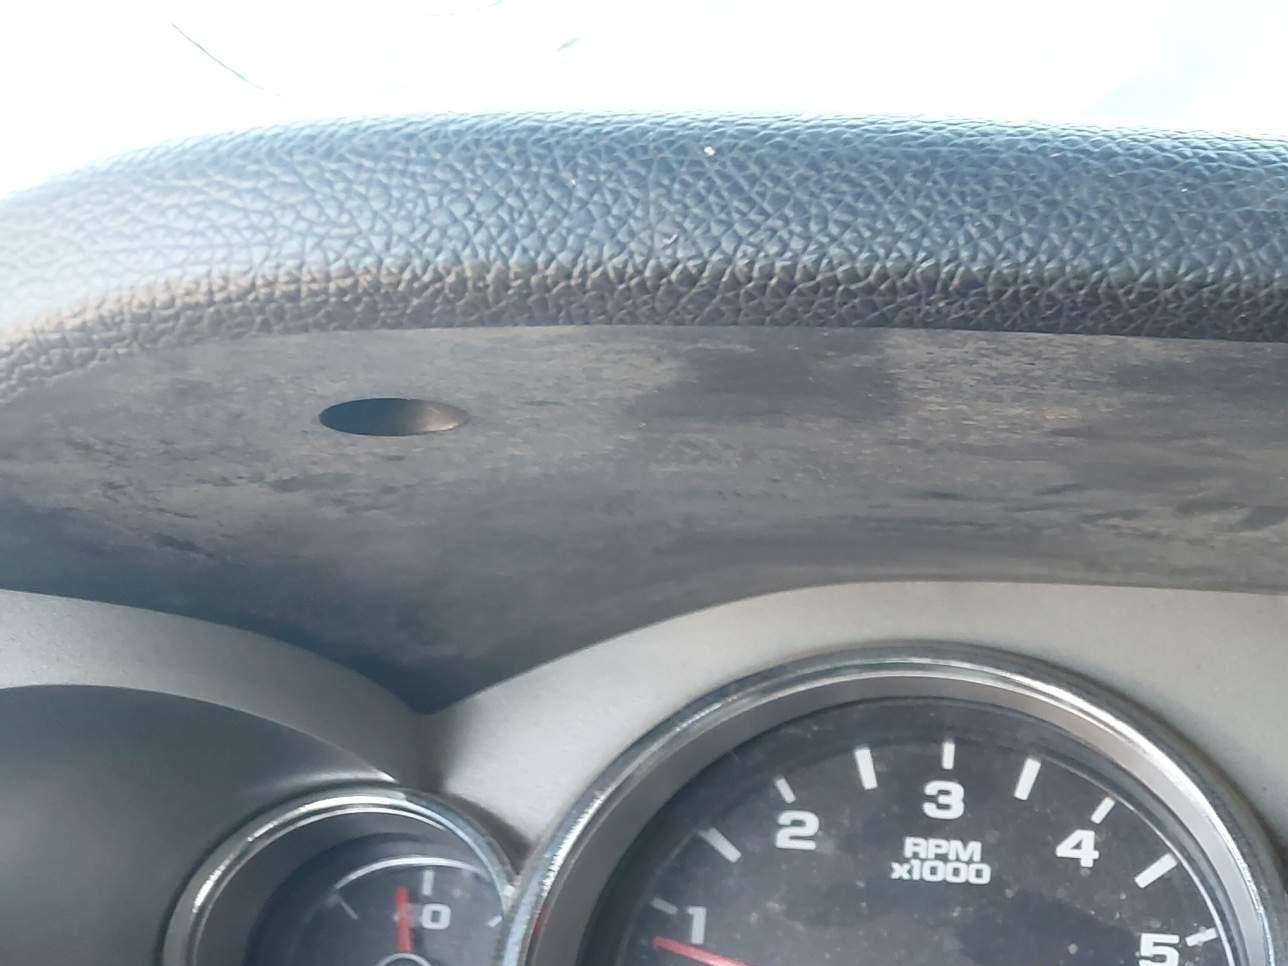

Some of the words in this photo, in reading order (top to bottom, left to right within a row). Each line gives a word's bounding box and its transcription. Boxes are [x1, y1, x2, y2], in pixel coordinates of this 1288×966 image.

[922, 779, 966, 820] 3
[775, 811, 820, 851] 2
[903, 836, 982, 861] RPM
[1056, 829, 1099, 868] 4
[890, 858, 992, 885] x1000
[687, 905, 707, 944] 1
